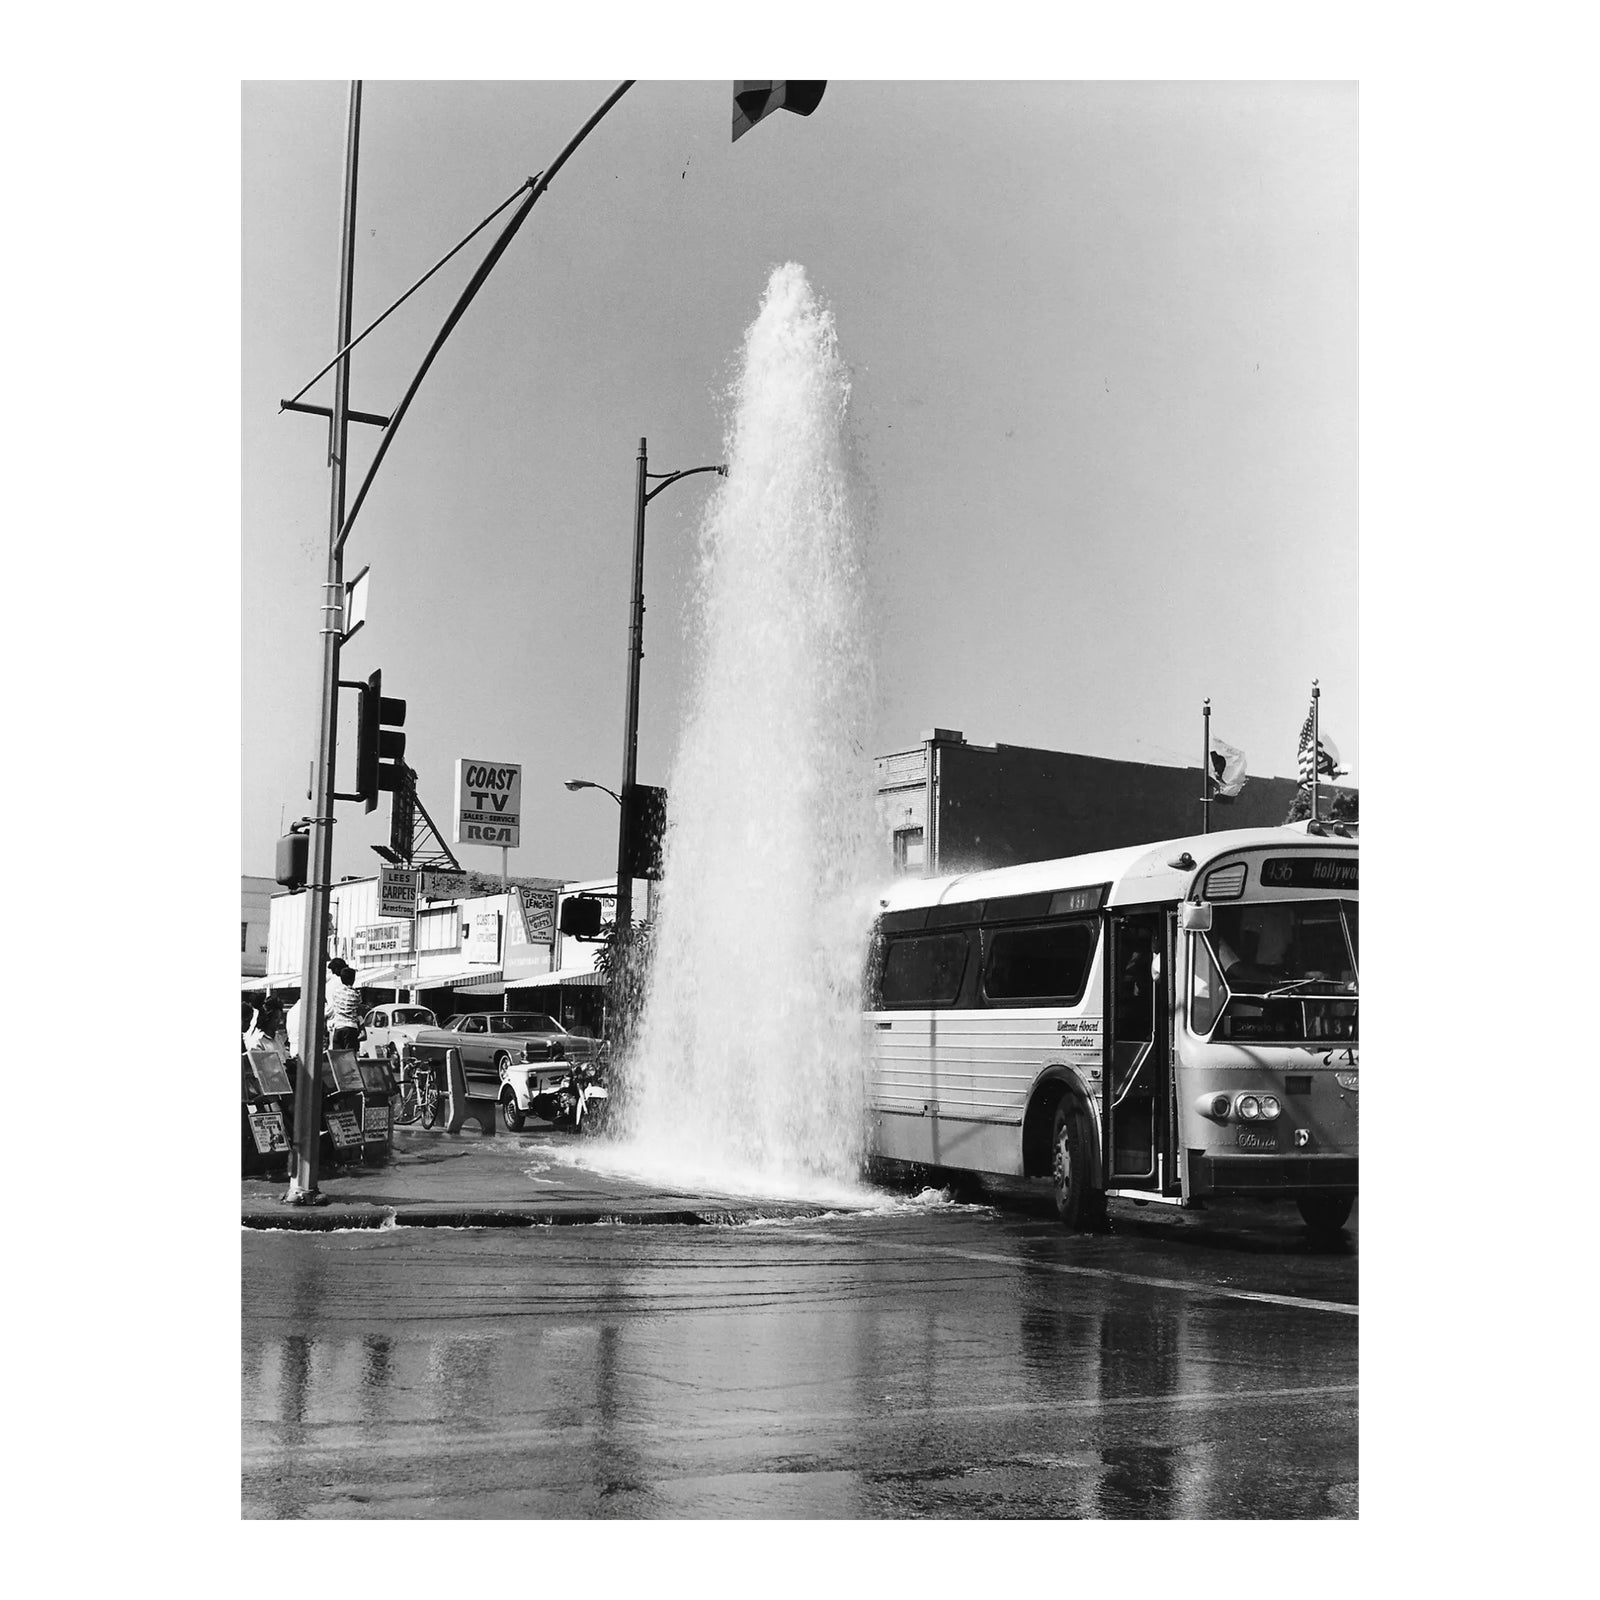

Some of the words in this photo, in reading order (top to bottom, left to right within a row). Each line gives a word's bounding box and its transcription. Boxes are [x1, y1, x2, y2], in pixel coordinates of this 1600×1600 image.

[466, 765, 518, 791] COAST
[470, 791, 509, 811] TV
[489, 815, 516, 823] SERVICE
[468, 825, 511, 842] RCA
[388, 873, 411, 882] LEES
[382, 885, 416, 900] CARPETS
[523, 890, 554, 900] GREAT
[382, 903, 414, 915] Armstrong
[525, 899, 554, 909] LENGTHS
[534, 919, 550, 929] GIFTS
[369, 941, 397, 951] WALLPAPER
[1057, 1020, 1078, 1031] Welcome
[1079, 1020, 1099, 1031] Aboard
[1061, 1035, 1094, 1047] Bienvenidos
[1317, 1047, 1359, 1066] 74
